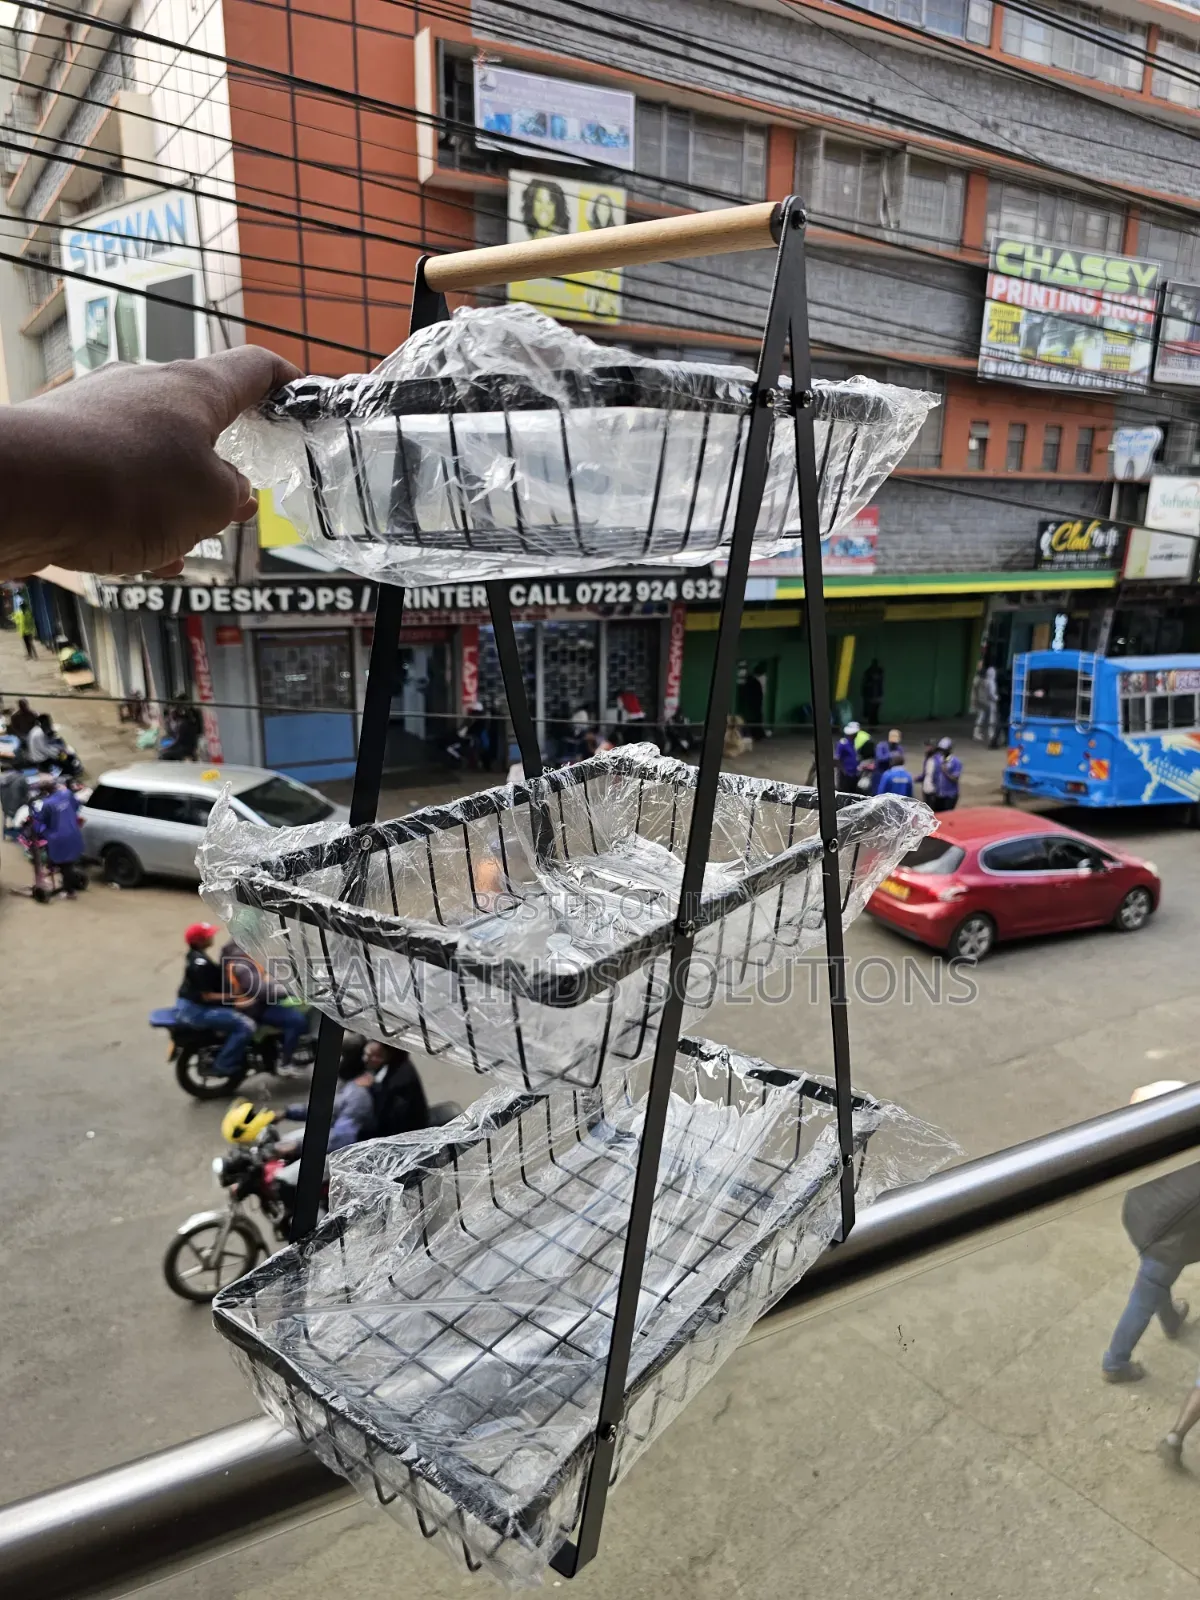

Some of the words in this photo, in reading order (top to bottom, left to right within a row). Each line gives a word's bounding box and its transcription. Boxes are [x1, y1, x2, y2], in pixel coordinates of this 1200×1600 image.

[995, 239, 1158, 297] CHASSY
[992, 277, 1095, 316] PRINTING
[1100, 291, 1153, 322] SHOP
[189, 585, 354, 612] DESKTOPS
[404, 584, 488, 609] RINTER
[508, 584, 570, 606] CALL
[576, 582, 631, 605] 0722
[636, 580, 677, 602] 924
[682, 578, 722, 600] 632
[666, 608, 686, 698] COMPUT
